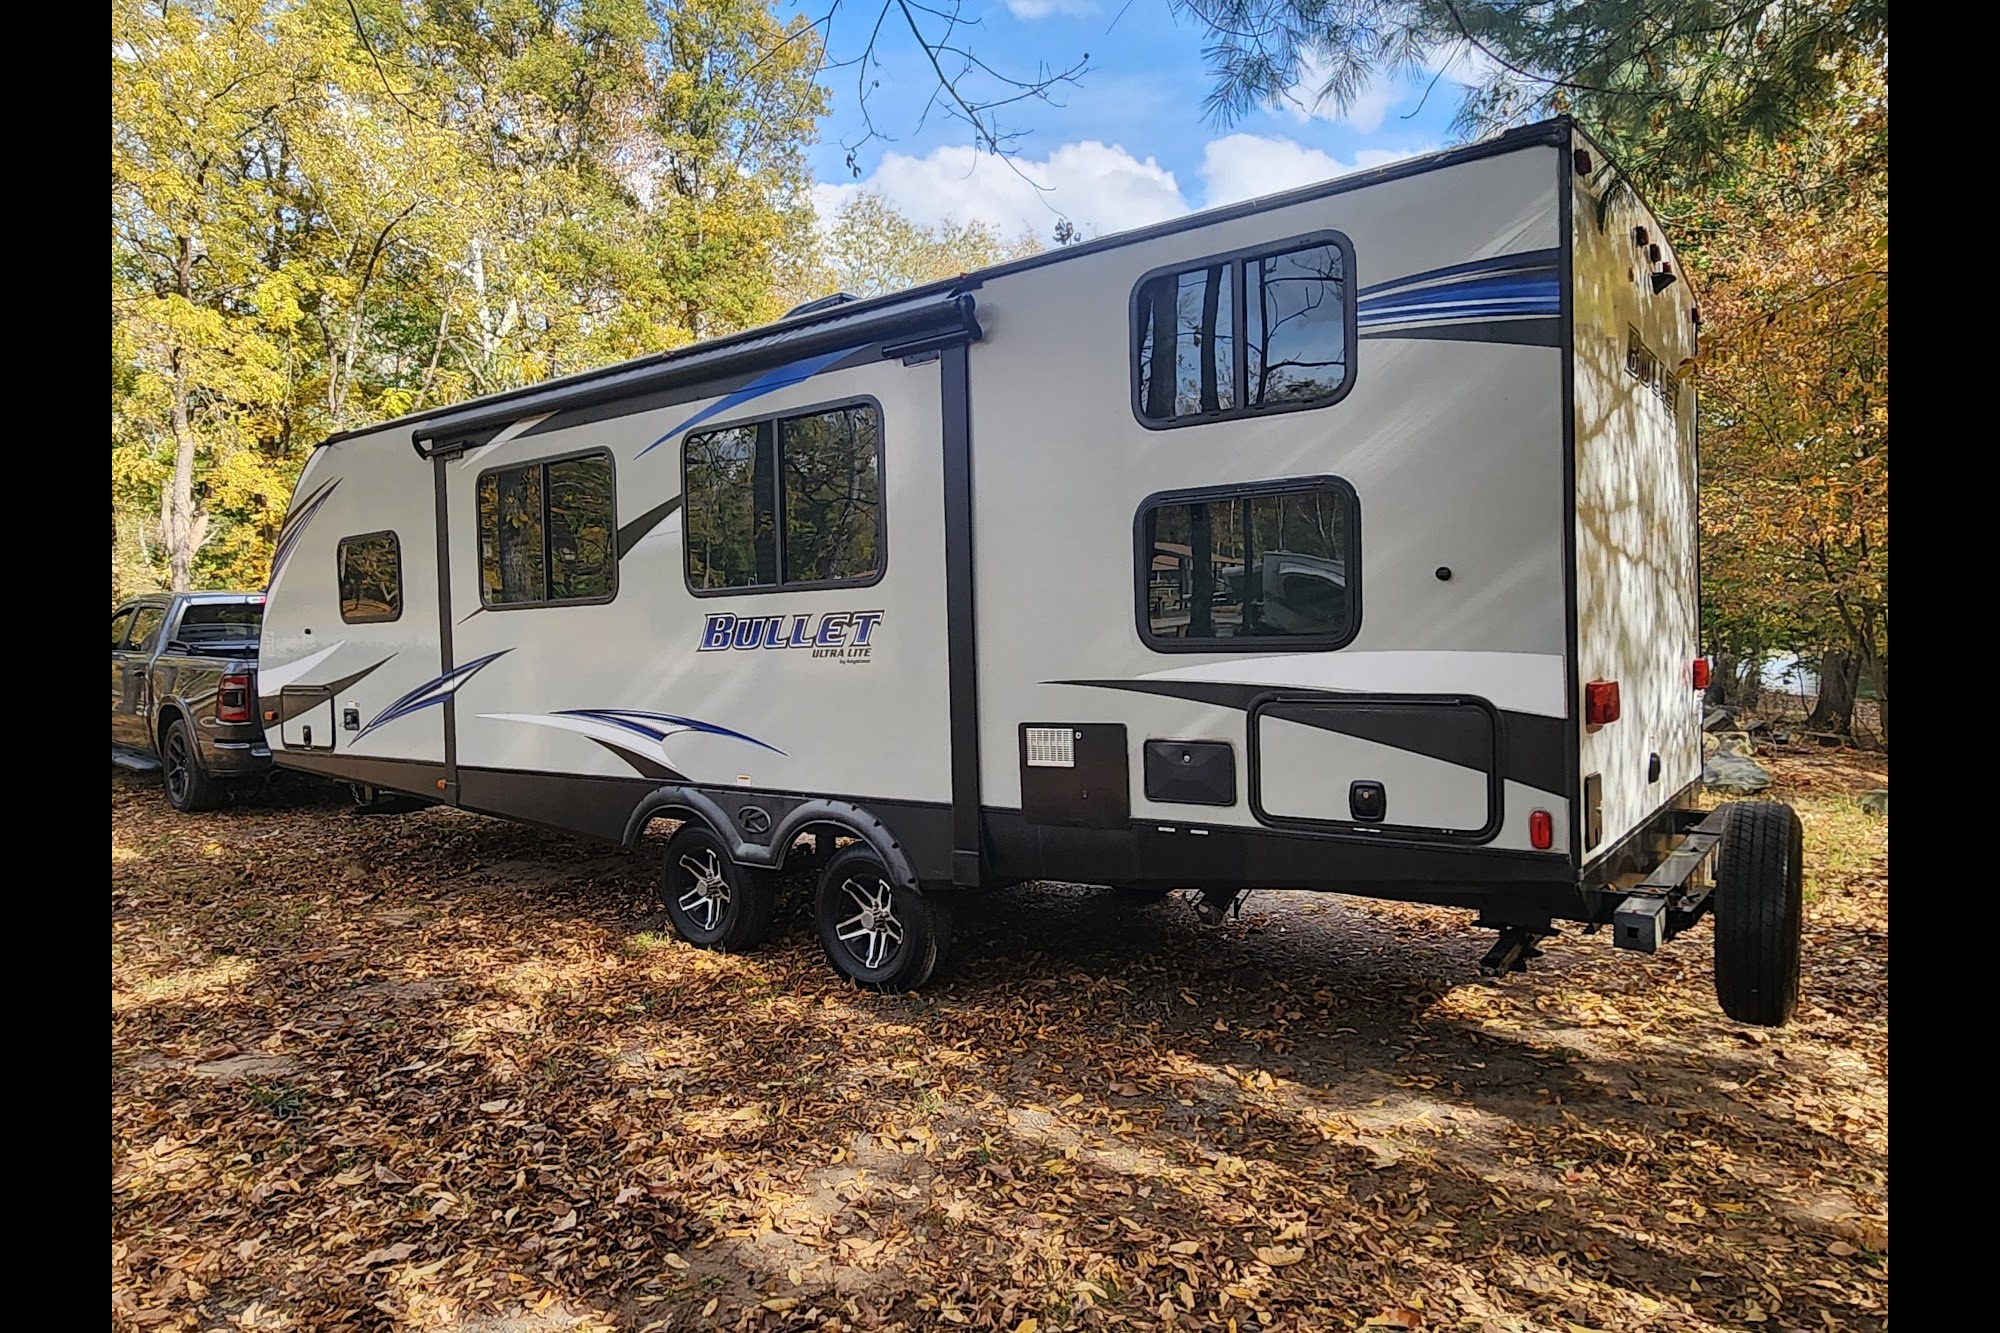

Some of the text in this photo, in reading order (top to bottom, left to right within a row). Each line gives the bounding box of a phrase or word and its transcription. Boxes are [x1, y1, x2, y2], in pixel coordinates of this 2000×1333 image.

[696, 610, 885, 652] BULLET
[812, 648, 872, 658] ULTRA LITE
